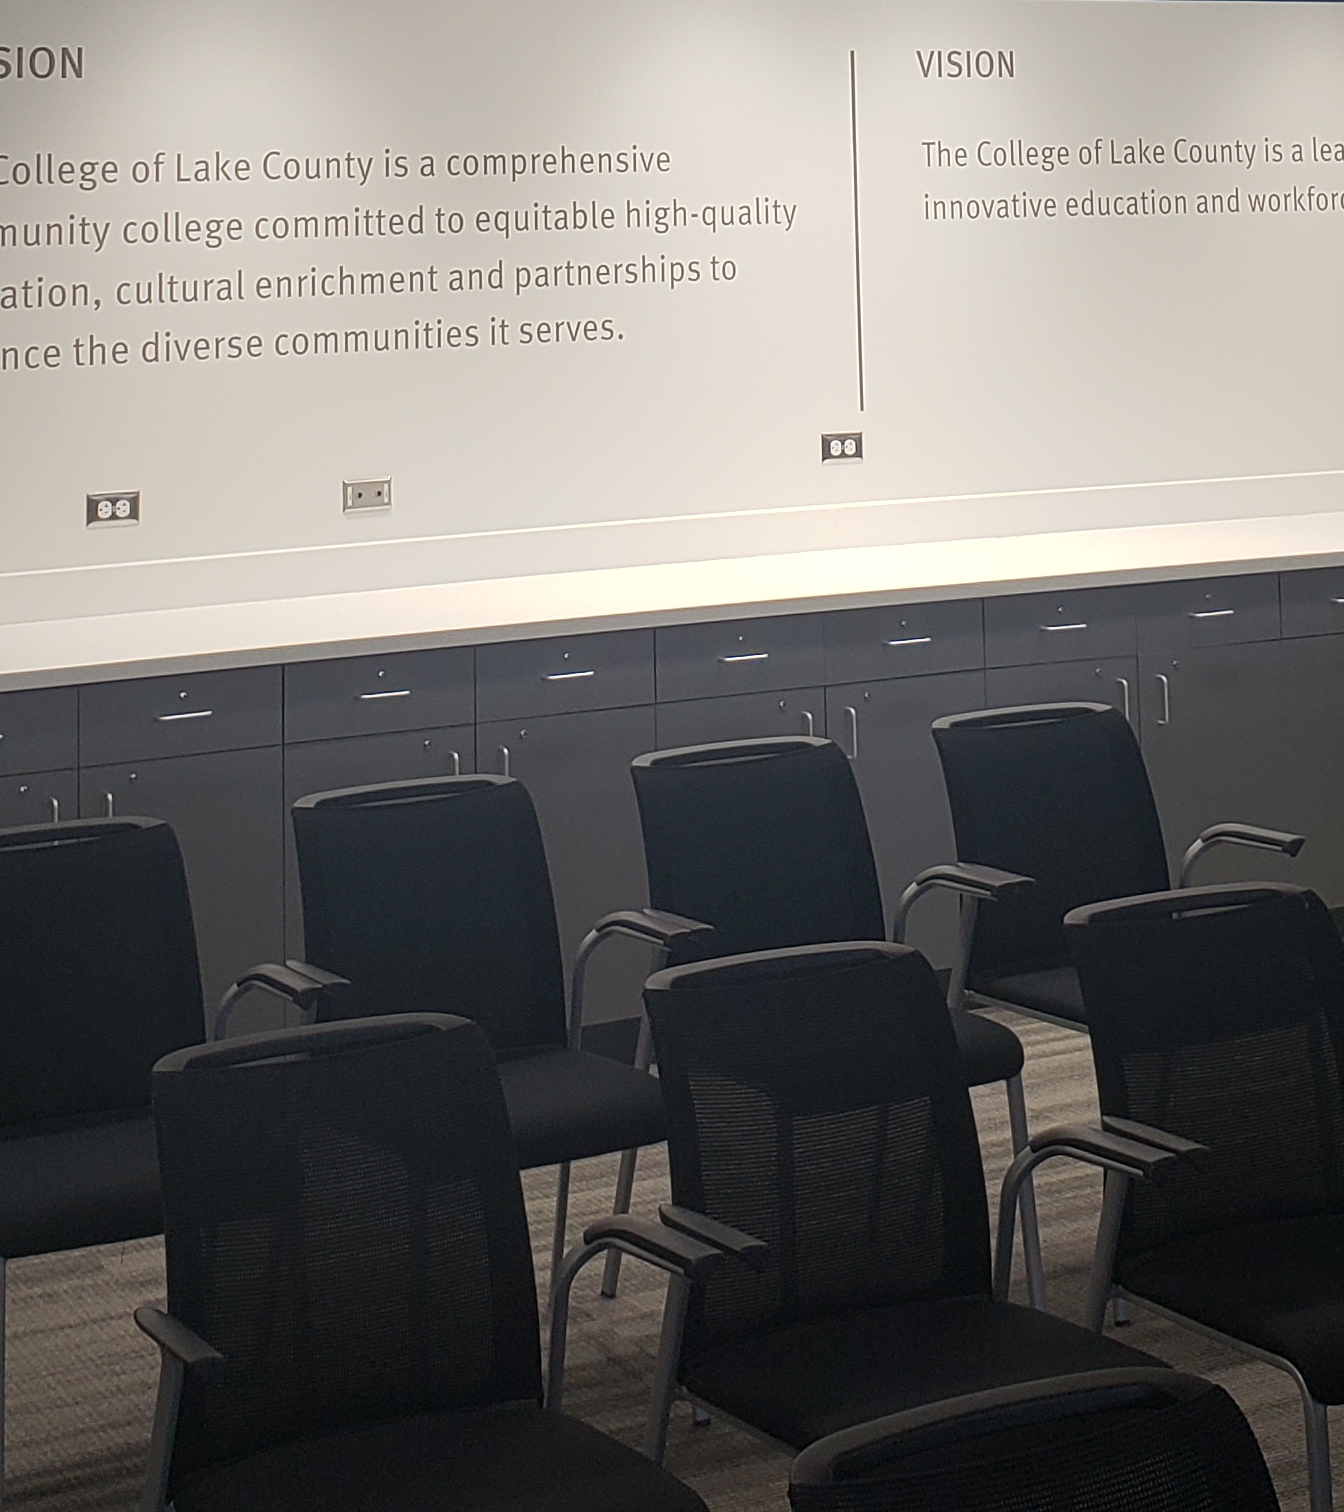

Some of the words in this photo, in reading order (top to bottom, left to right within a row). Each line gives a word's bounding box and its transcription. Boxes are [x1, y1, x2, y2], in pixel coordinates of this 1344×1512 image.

[915, 50, 1015, 78] VISION
[131, 152, 166, 184] of
[176, 150, 251, 183] Lake
[262, 151, 374, 187] County
[384, 148, 409, 178] is
[420, 155, 436, 177] a
[446, 144, 671, 183] comprehensive
[921, 140, 968, 168] The
[977, 139, 1070, 172] College
[1078, 138, 1103, 166] of
[1110, 137, 1165, 165] Lake
[1173, 138, 1257, 170] County
[1264, 137, 1283, 163] is
[1291, 143, 1304, 163] a
[122, 211, 243, 249] college
[255, 204, 424, 240] committed
[434, 207, 464, 234] to
[475, 200, 615, 240] equitable
[626, 196, 797, 234] high-quality
[924, 191, 1057, 220] innovative
[1066, 188, 1187, 217] education
[1196, 186, 1240, 214] and
[116, 269, 245, 305] cultural
[255, 265, 439, 299] enrichment
[448, 259, 503, 292] and
[515, 254, 701, 296] partnerships
[710, 255, 737, 281] to
[72, 334, 129, 367] the
[141, 331, 263, 363] diverse
[274, 318, 479, 356] communities
[490, 316, 510, 346] it
[519, 319, 624, 345] serves.
